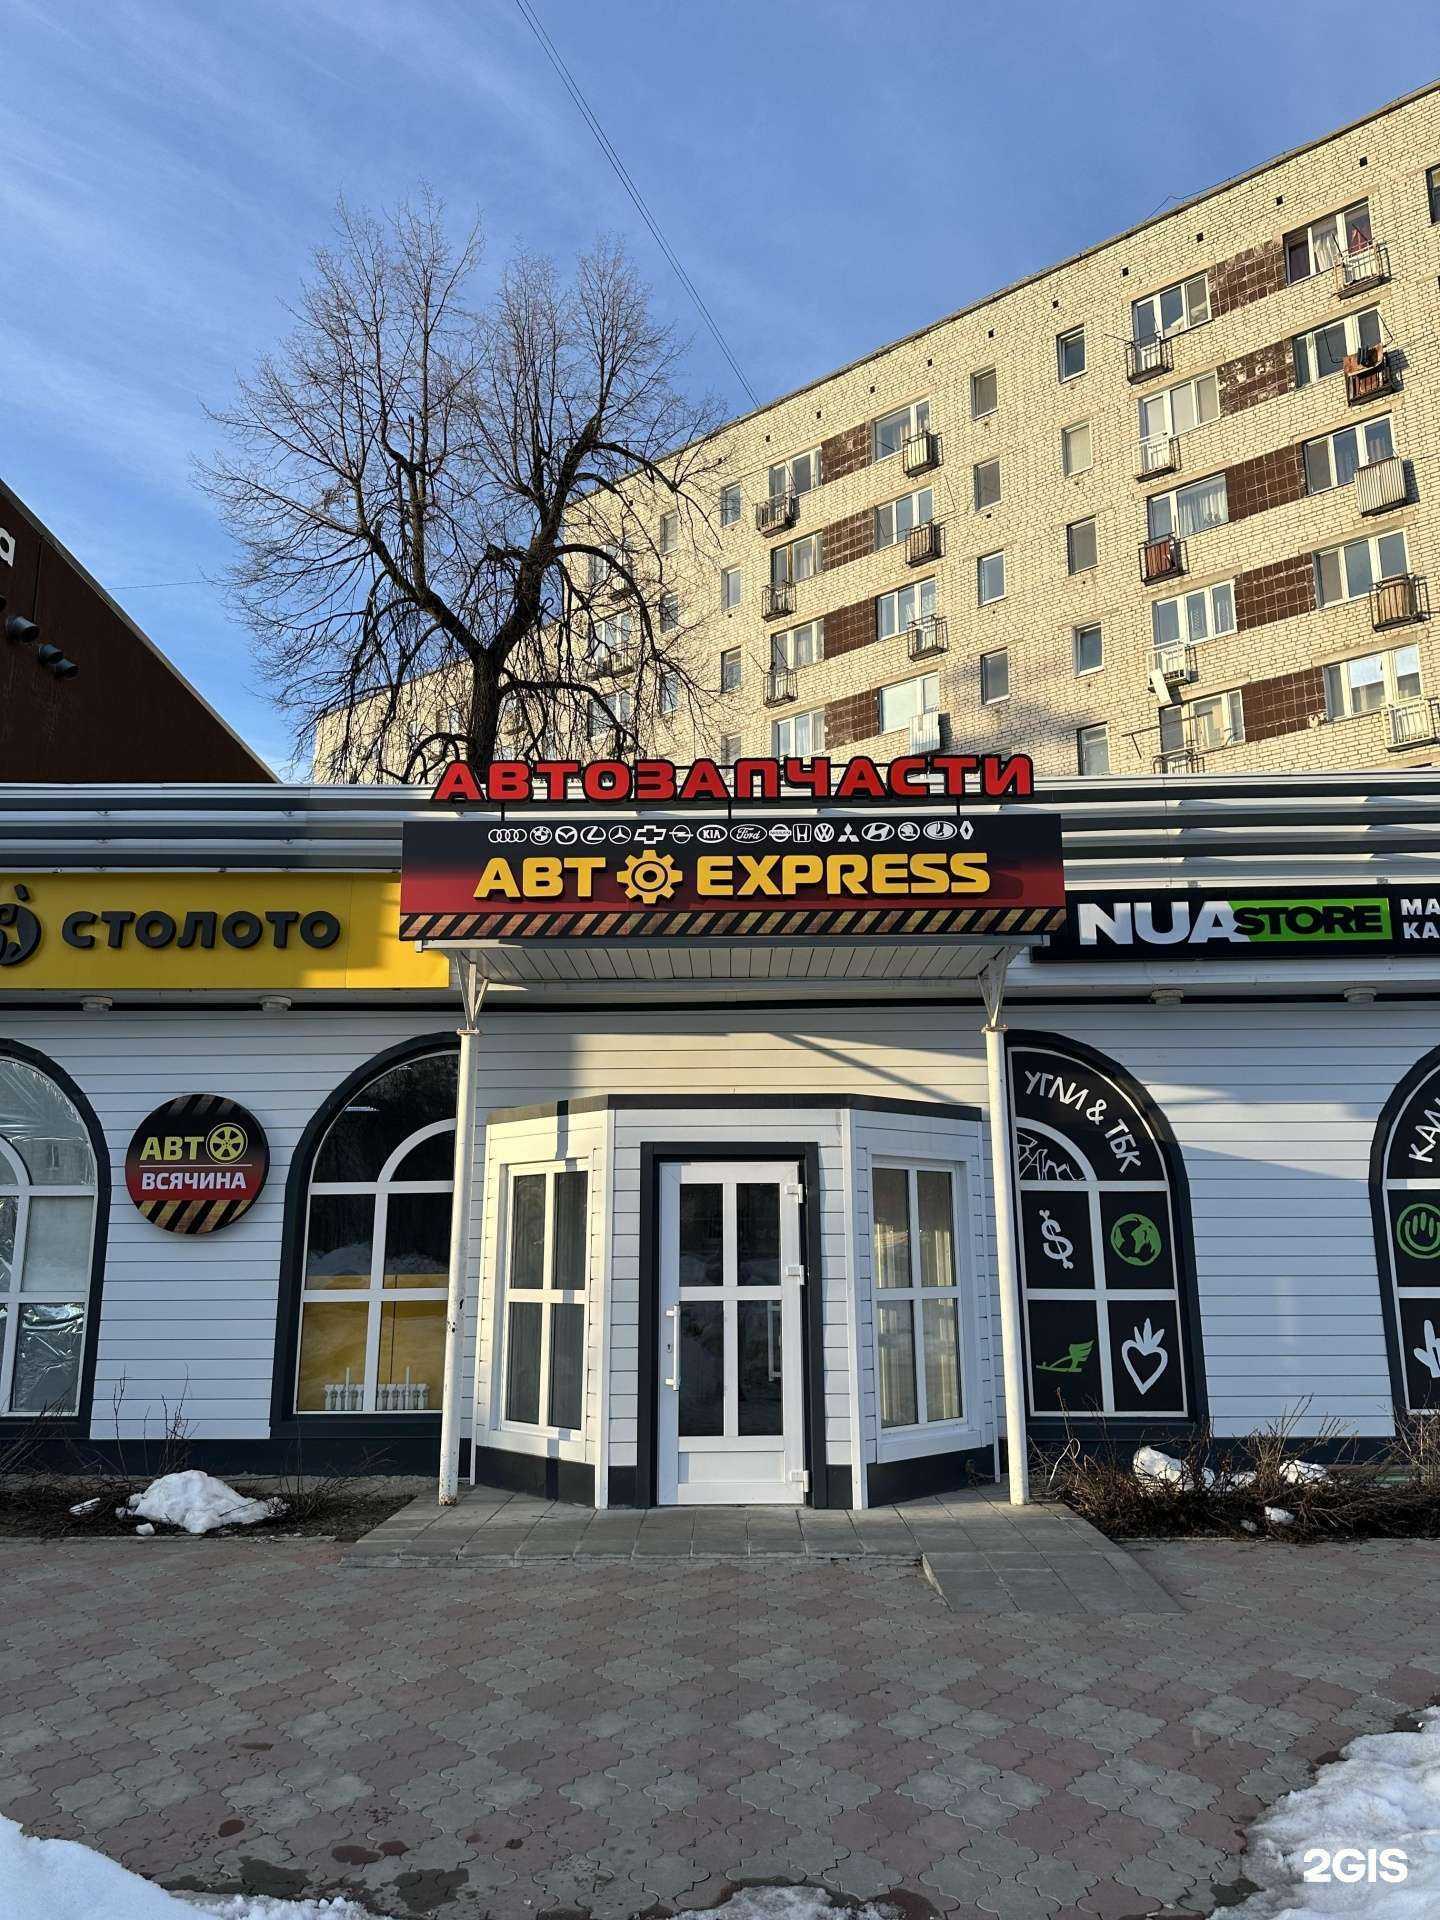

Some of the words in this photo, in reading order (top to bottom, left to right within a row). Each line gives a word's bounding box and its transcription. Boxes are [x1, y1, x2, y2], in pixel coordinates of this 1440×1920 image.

[431, 754, 1034, 802] АВТОЗАПЧАСТИ
[702, 829, 721, 839] KIA
[736, 827, 761, 840] Ford
[697, 852, 991, 896] EXPRESS
[62, 910, 341, 949] СТОЛОТО
[1077, 900, 1253, 945] NUA
[1233, 905, 1384, 935] STORE
[1024, 1070, 1090, 1111] УГЛИ
[1085, 1099, 1107, 1125] &
[1104, 1118, 1141, 1174] ТБК
[141, 1172, 247, 1190] ВСЯЧИНА
